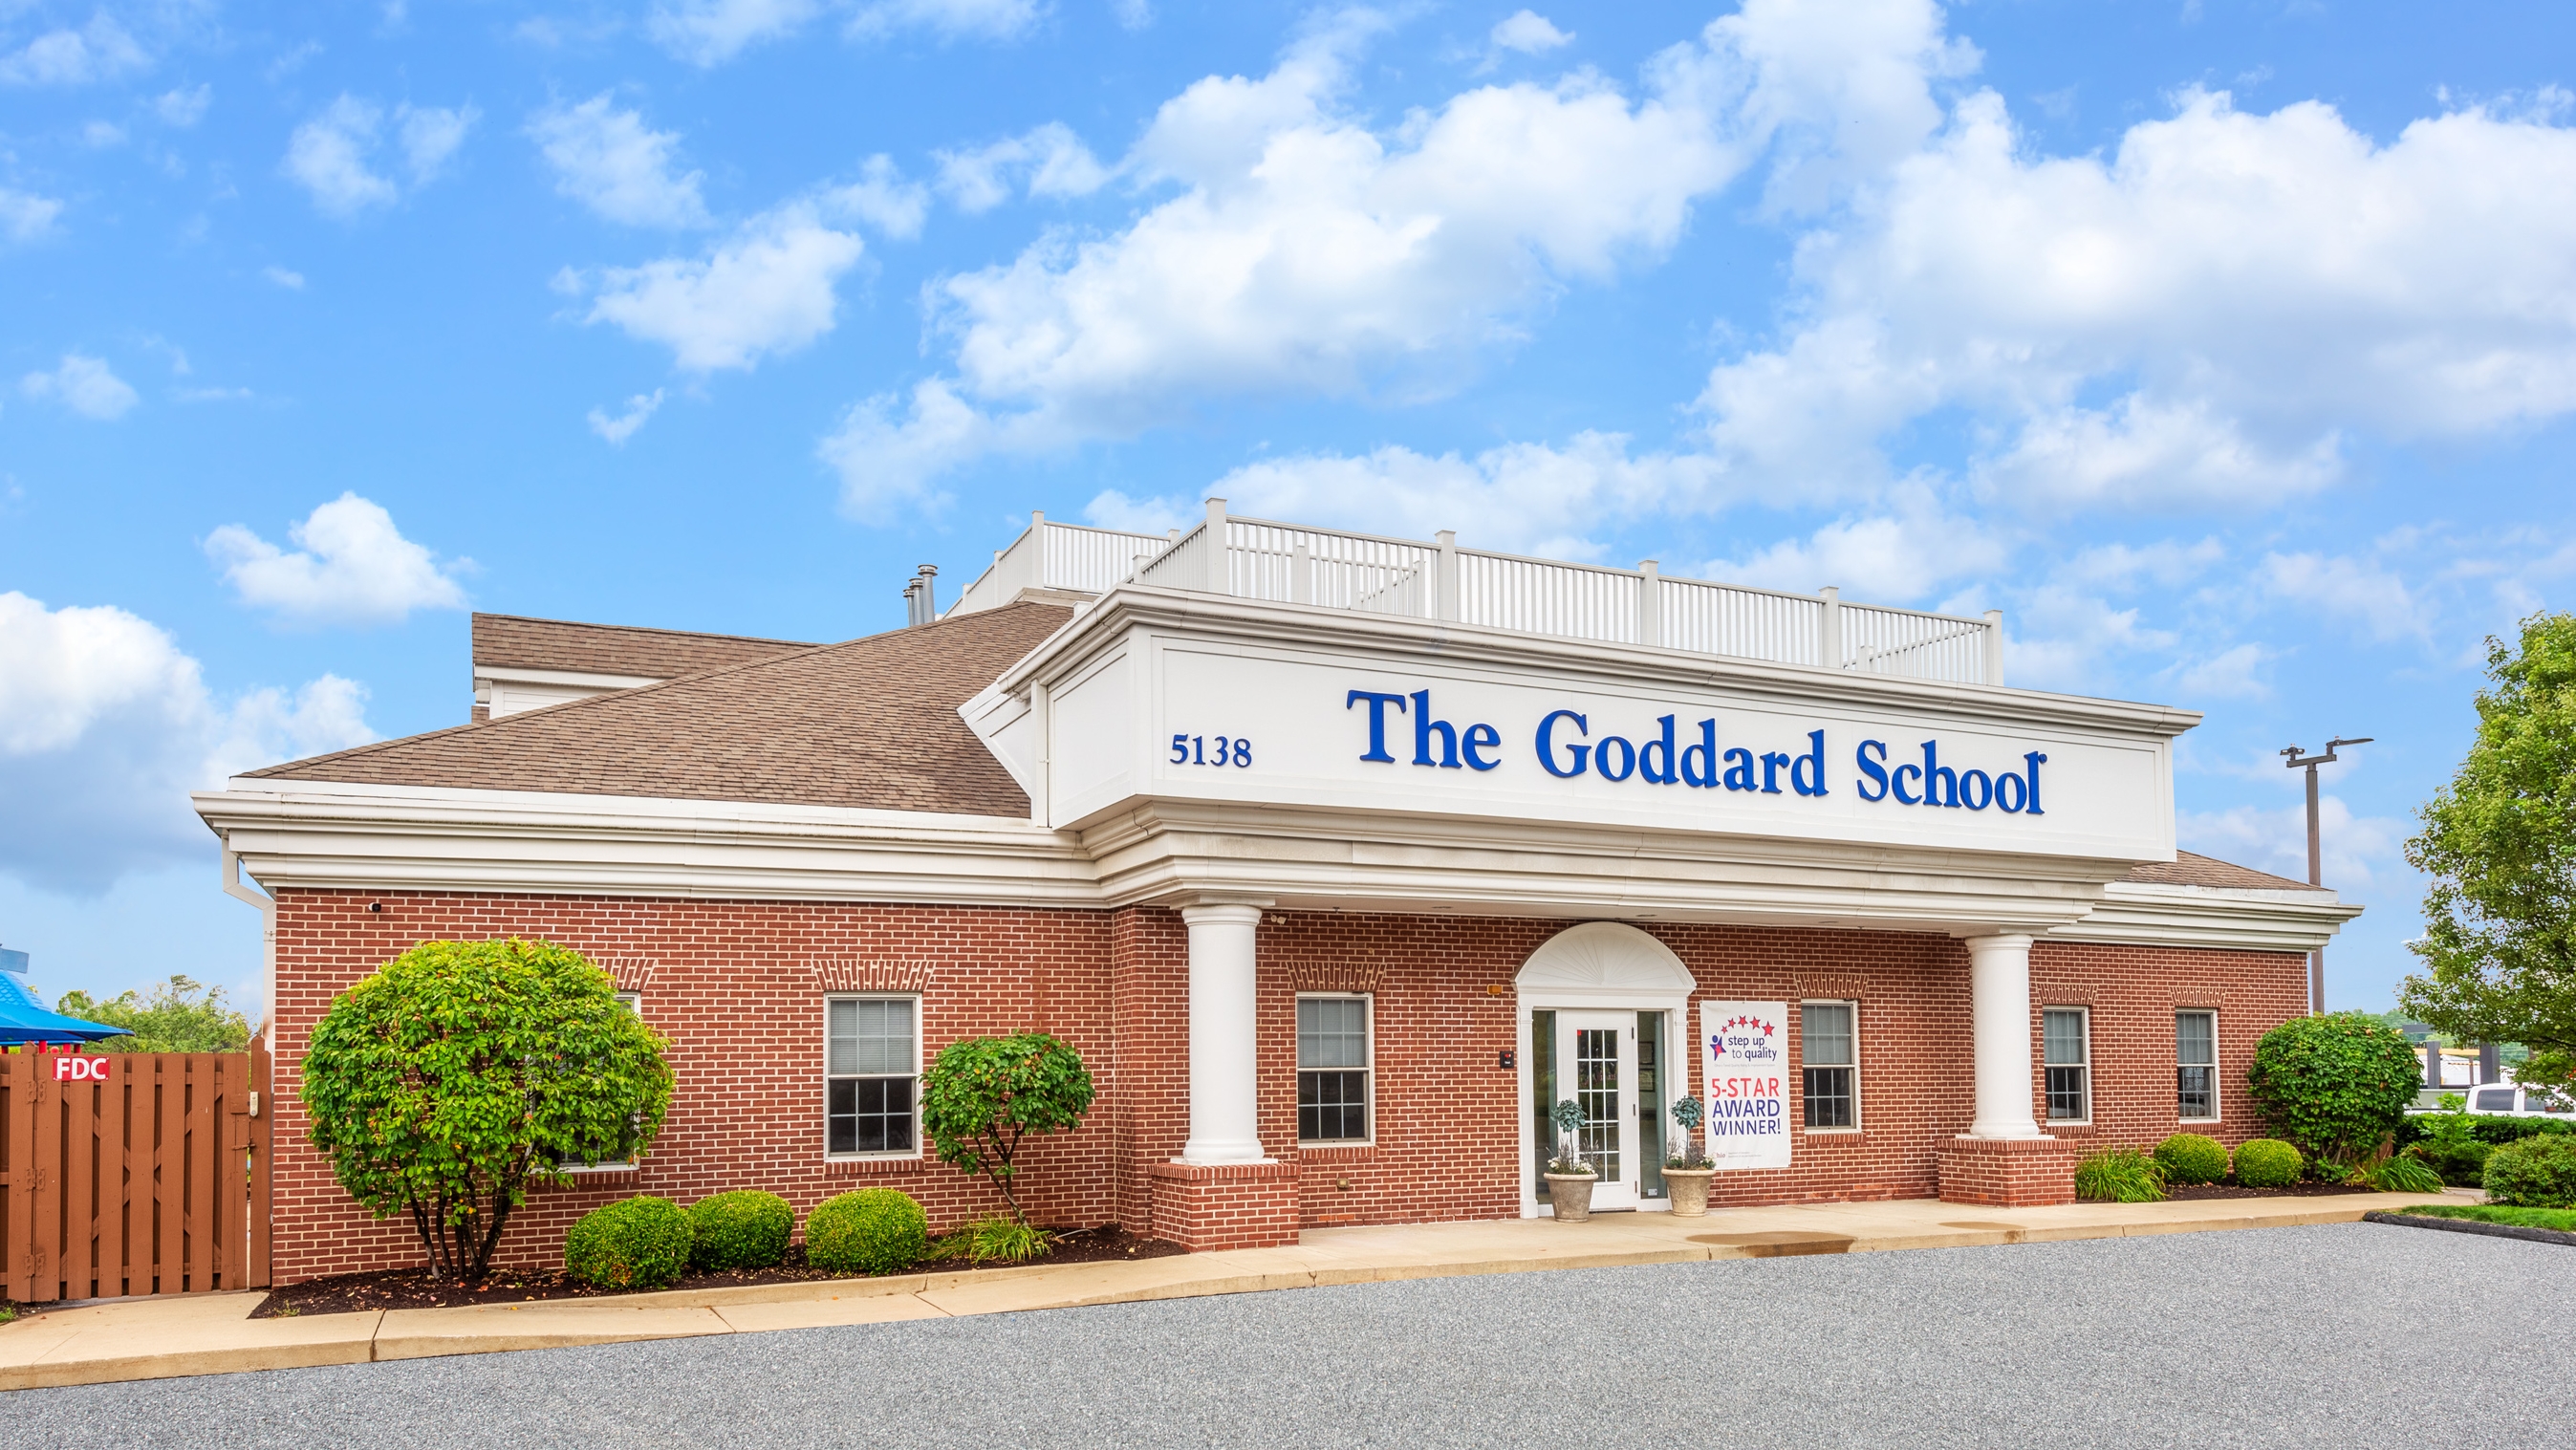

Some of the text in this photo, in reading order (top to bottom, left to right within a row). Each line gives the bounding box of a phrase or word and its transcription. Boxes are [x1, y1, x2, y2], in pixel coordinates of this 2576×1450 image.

[1172, 735, 1252, 766] 5138
[1347, 690, 2047, 814] The Goddard School
[1727, 1037, 1765, 1050] step up
[1732, 1047, 1778, 1062] to quality
[56, 1057, 107, 1080] FDC
[1712, 1078, 1780, 1098] 5-STAR
[1712, 1099, 1781, 1118] AWARD
[1713, 1118, 1781, 1136] WINNER!
